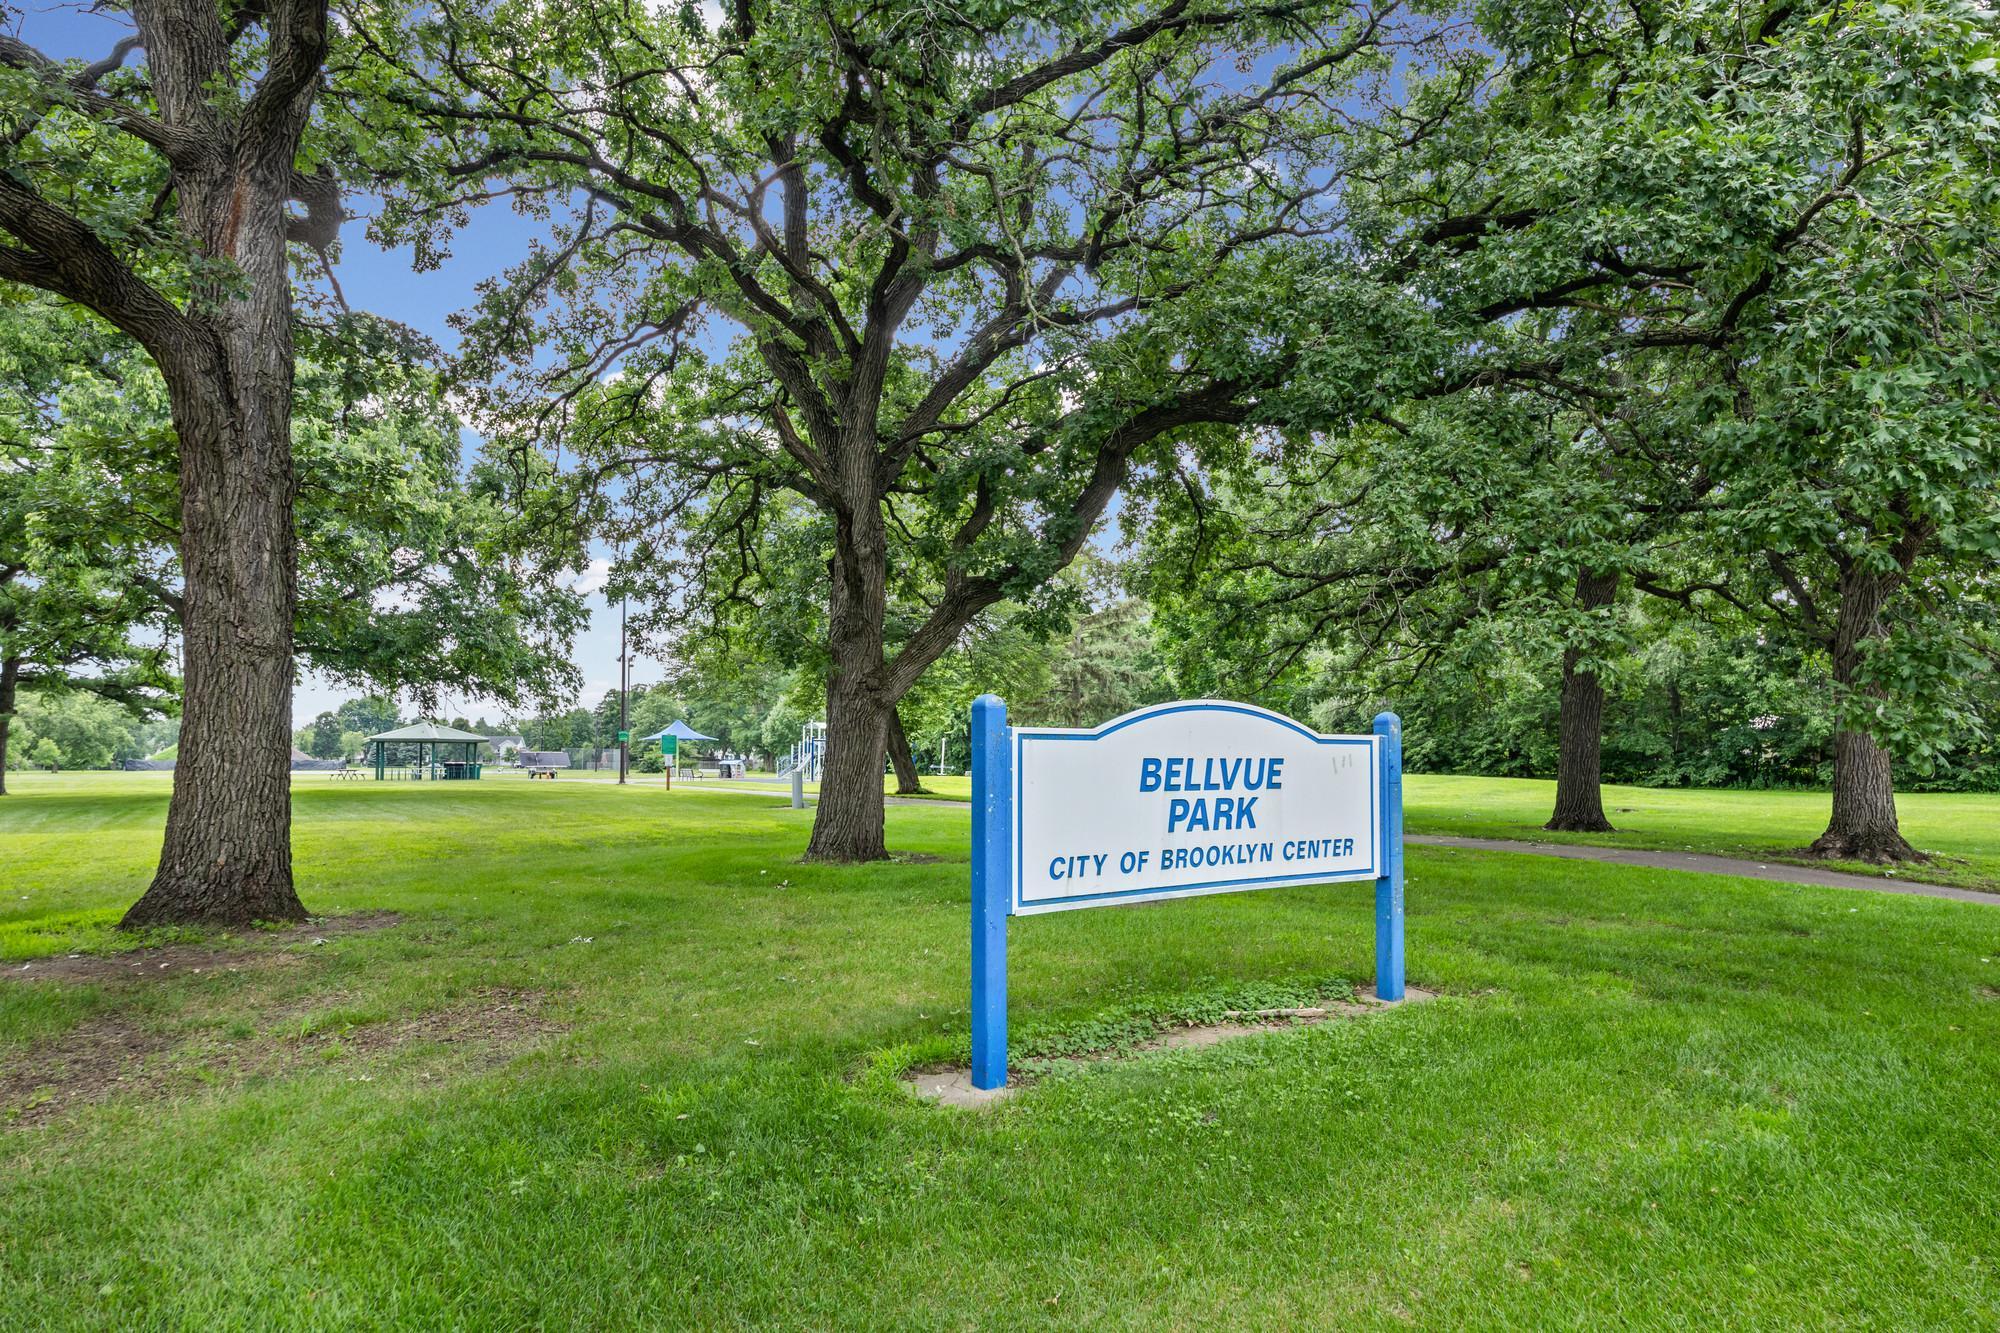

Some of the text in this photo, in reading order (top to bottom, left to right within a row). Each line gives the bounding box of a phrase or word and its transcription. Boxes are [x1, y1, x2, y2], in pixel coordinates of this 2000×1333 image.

[1138, 757, 1285, 793] BELLVUE
[1168, 797, 1258, 833] PARK
[1049, 838, 1355, 881] CITY OF BROOKLYN CENTER
